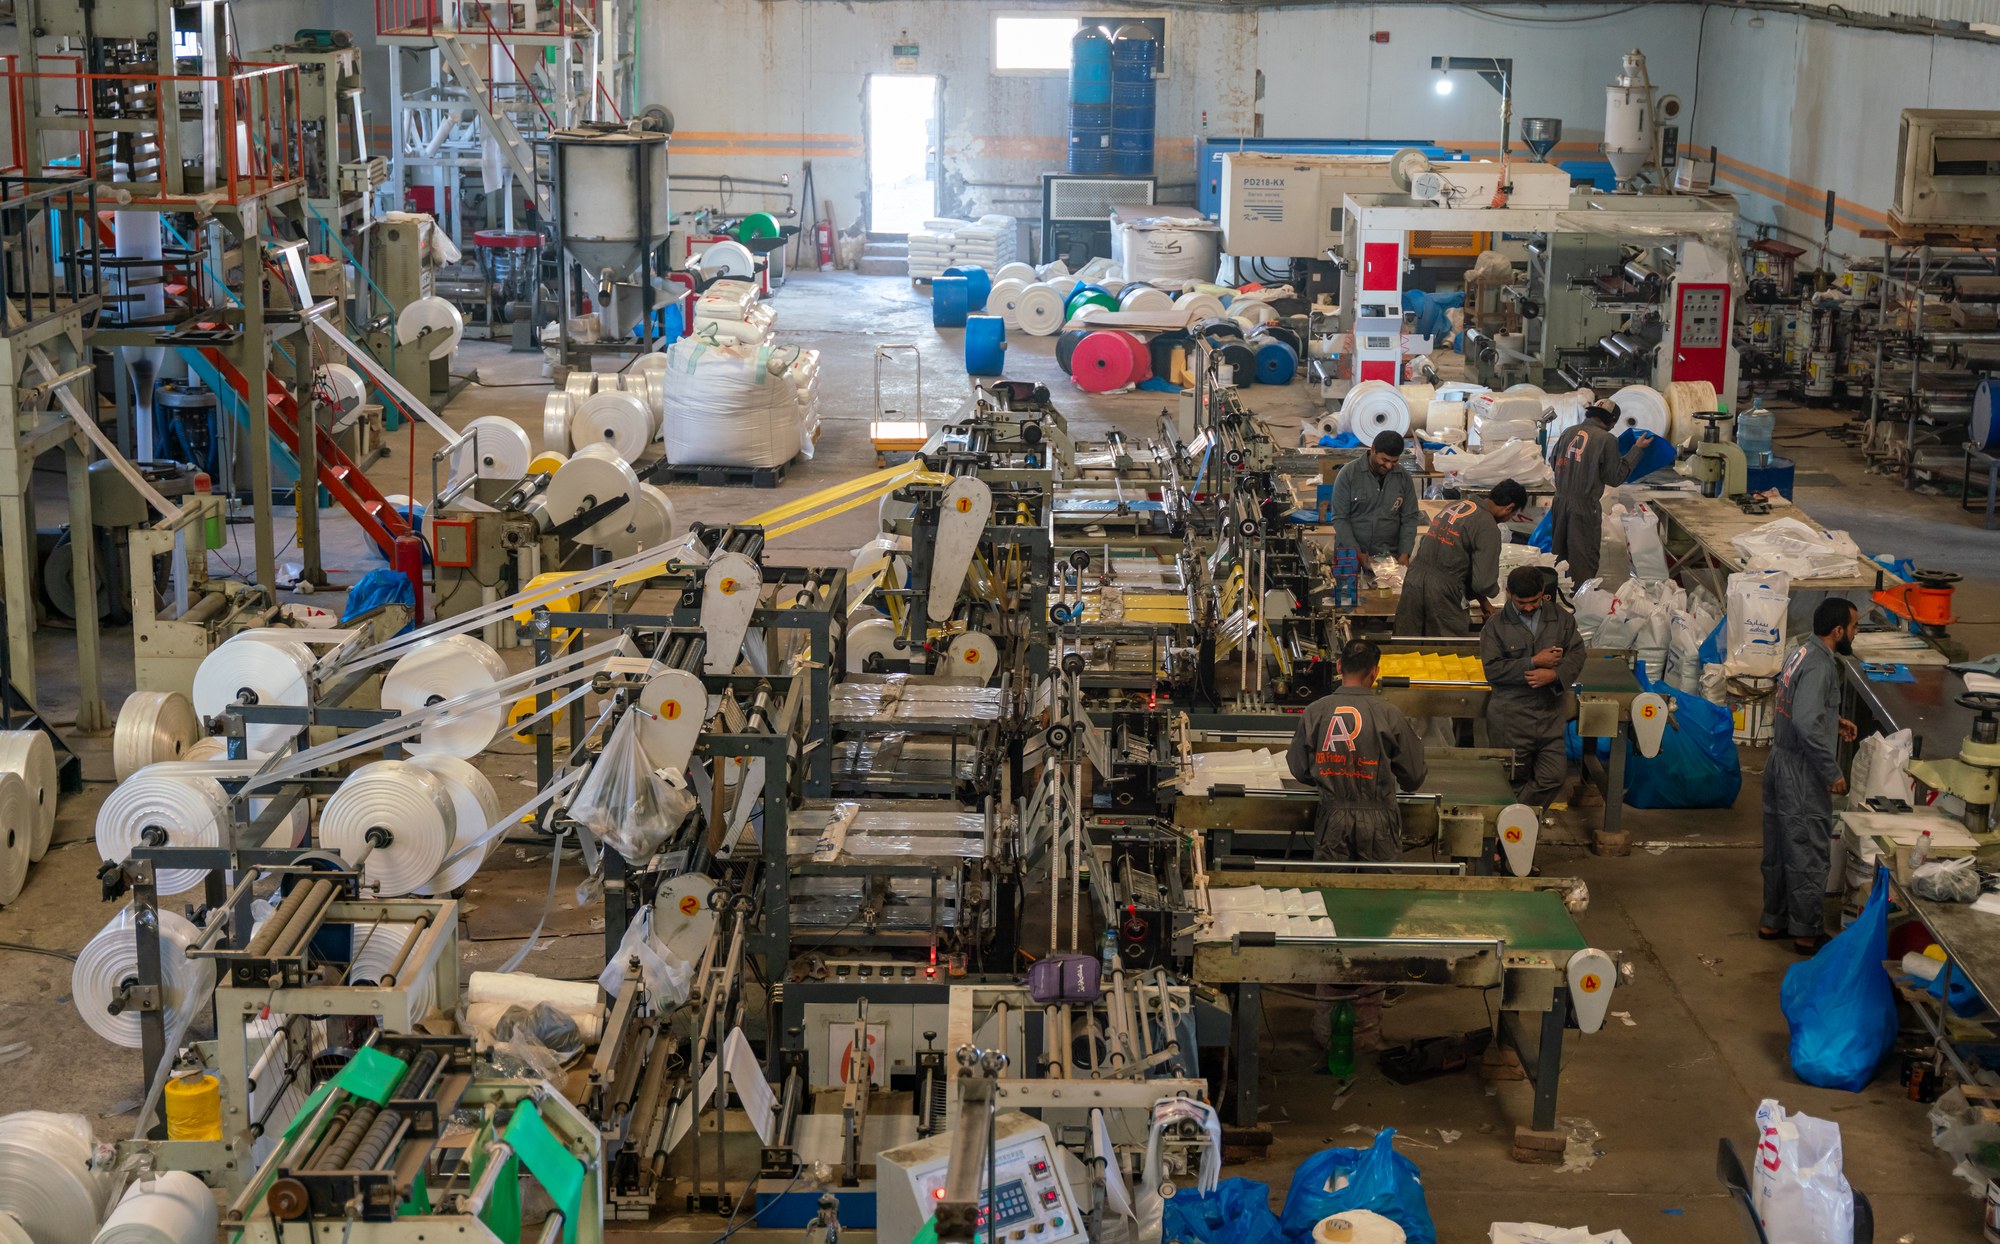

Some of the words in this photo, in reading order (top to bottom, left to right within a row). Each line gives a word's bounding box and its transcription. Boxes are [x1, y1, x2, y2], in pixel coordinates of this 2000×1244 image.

[1243, 178, 1285, 187] PD218-KX
[961, 499, 968, 512] 1
[966, 650, 977, 663] 2
[667, 702, 675, 718] 1
[1644, 706, 1653, 718] 5
[1326, 752, 1347, 766] Factory
[1505, 830, 1521, 840] 2
[681, 897, 697, 914] 2
[1585, 975, 1597, 990] 4
